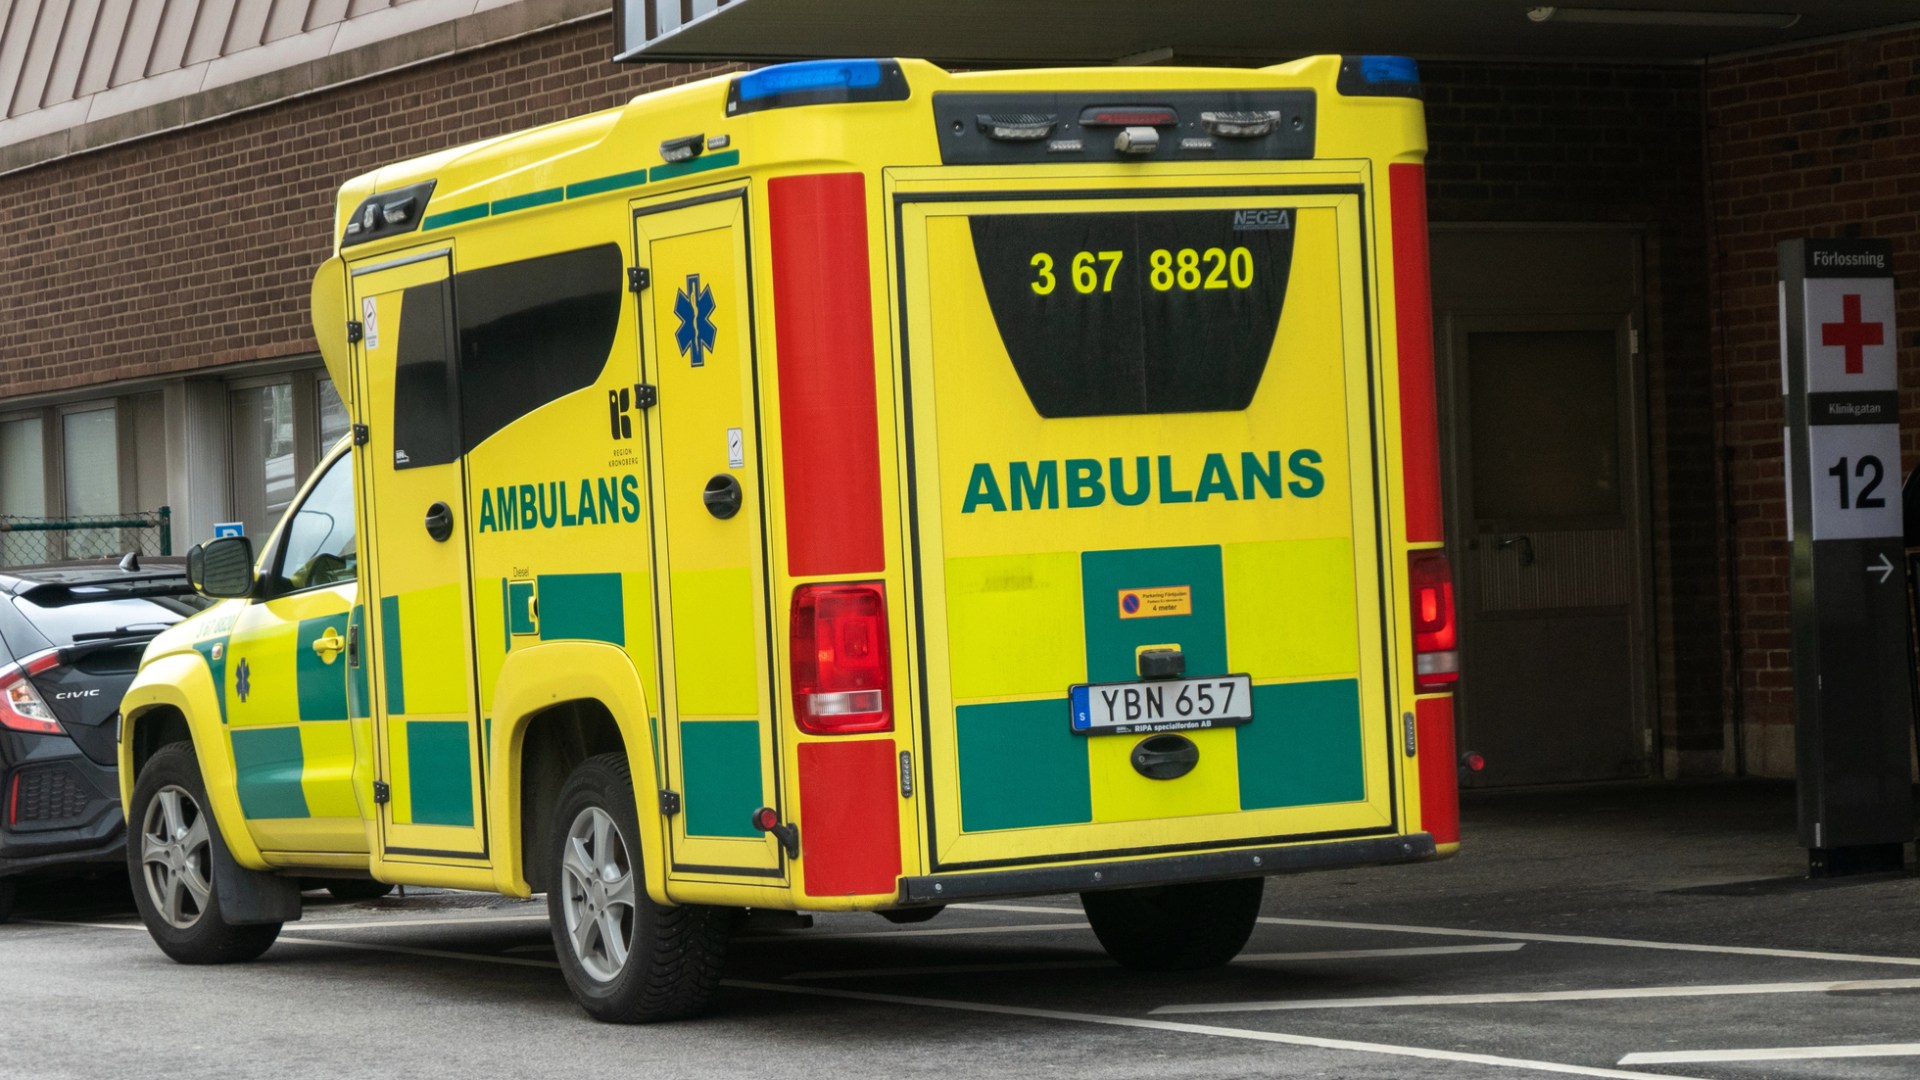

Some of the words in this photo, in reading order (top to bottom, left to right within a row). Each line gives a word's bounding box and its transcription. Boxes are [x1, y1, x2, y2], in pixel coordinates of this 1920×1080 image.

[1813, 251, 1885, 268] Förlossning
[1030, 252, 1056, 295] 3
[1071, 250, 1123, 294] 67
[1150, 246, 1254, 291] 8820
[1828, 403, 1881, 416] Klinikgatan
[613, 448, 632, 457] REGION
[608, 457, 638, 467] KRONOBERG
[961, 448, 1324, 514] AMBULANS
[1828, 454, 1885, 509] 12
[479, 474, 640, 533] AMBULANS
[55, 689, 100, 700] CIVIC
[1101, 686, 1164, 722] YBN
[1175, 682, 1235, 717] 657
[1079, 712, 1086, 722] S
[1134, 723, 1153, 733] RIPA
[1154, 721, 1199, 732] specialfordon
[1201, 720, 1212, 728] AB
